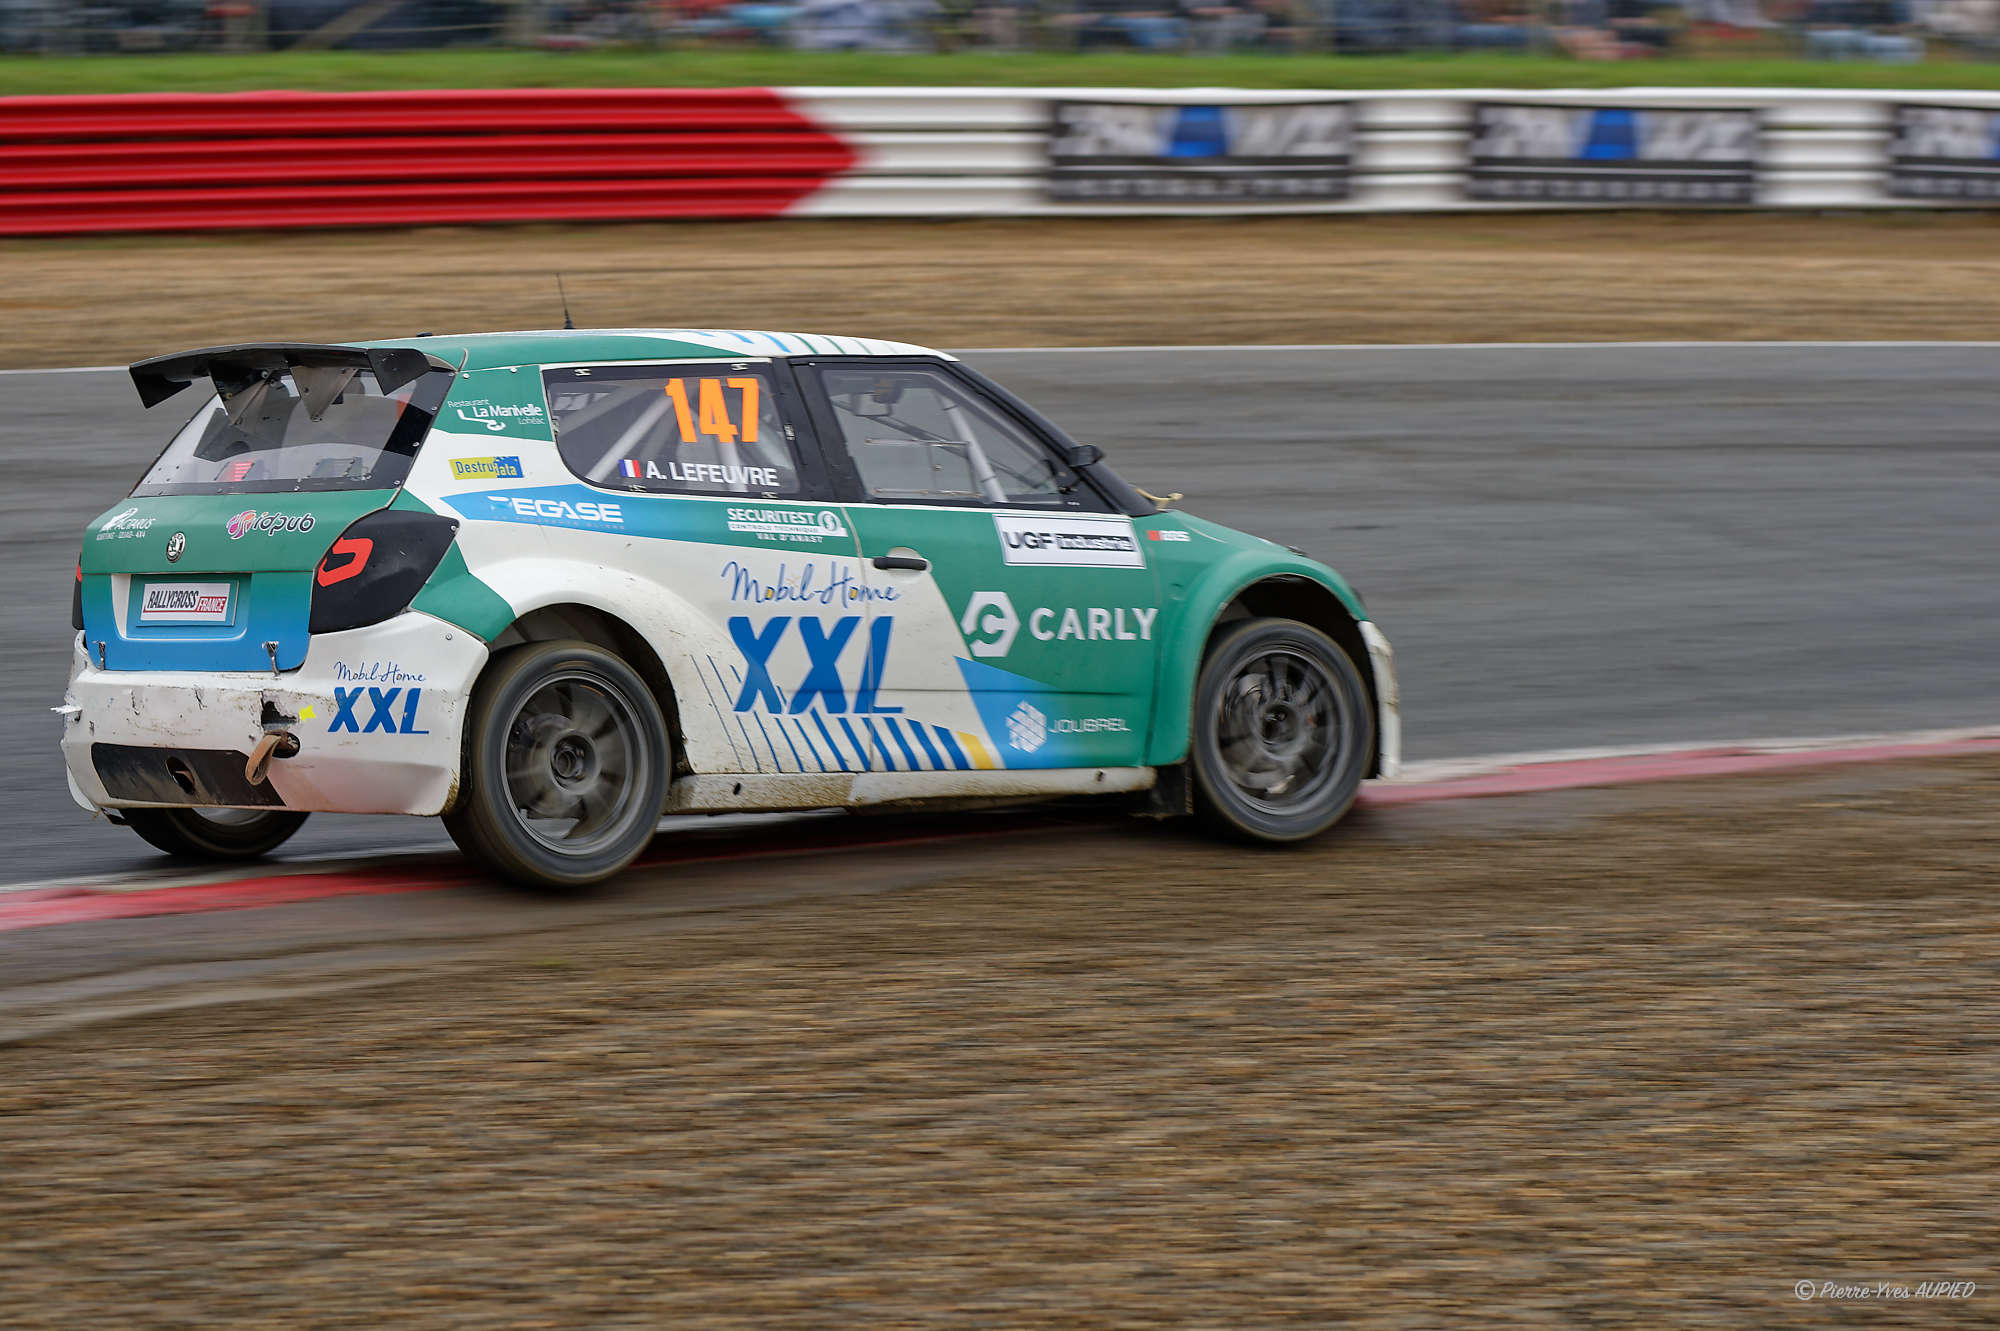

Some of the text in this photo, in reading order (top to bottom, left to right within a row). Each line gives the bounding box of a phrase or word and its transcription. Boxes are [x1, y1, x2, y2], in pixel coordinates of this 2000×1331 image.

[447, 399, 489, 408] Restaurant
[472, 403, 544, 417] La Manivelle
[665, 377, 760, 443] 147
[645, 461, 780, 487] A. LEFEUVRE
[727, 508, 816, 525] SECURITEST
[1003, 531, 1055, 549] UGF
[1055, 534, 1135, 550] industrie
[720, 561, 901, 608] Mobil-Home
[146, 590, 224, 612] RALLYCROSS FRANCE
[1029, 607, 1159, 641] CARLY
[333, 661, 426, 685] Mobil-Home
[727, 616, 904, 714] XXL
[327, 686, 430, 734] XXL
[1047, 717, 1132, 733] JOUBREL
